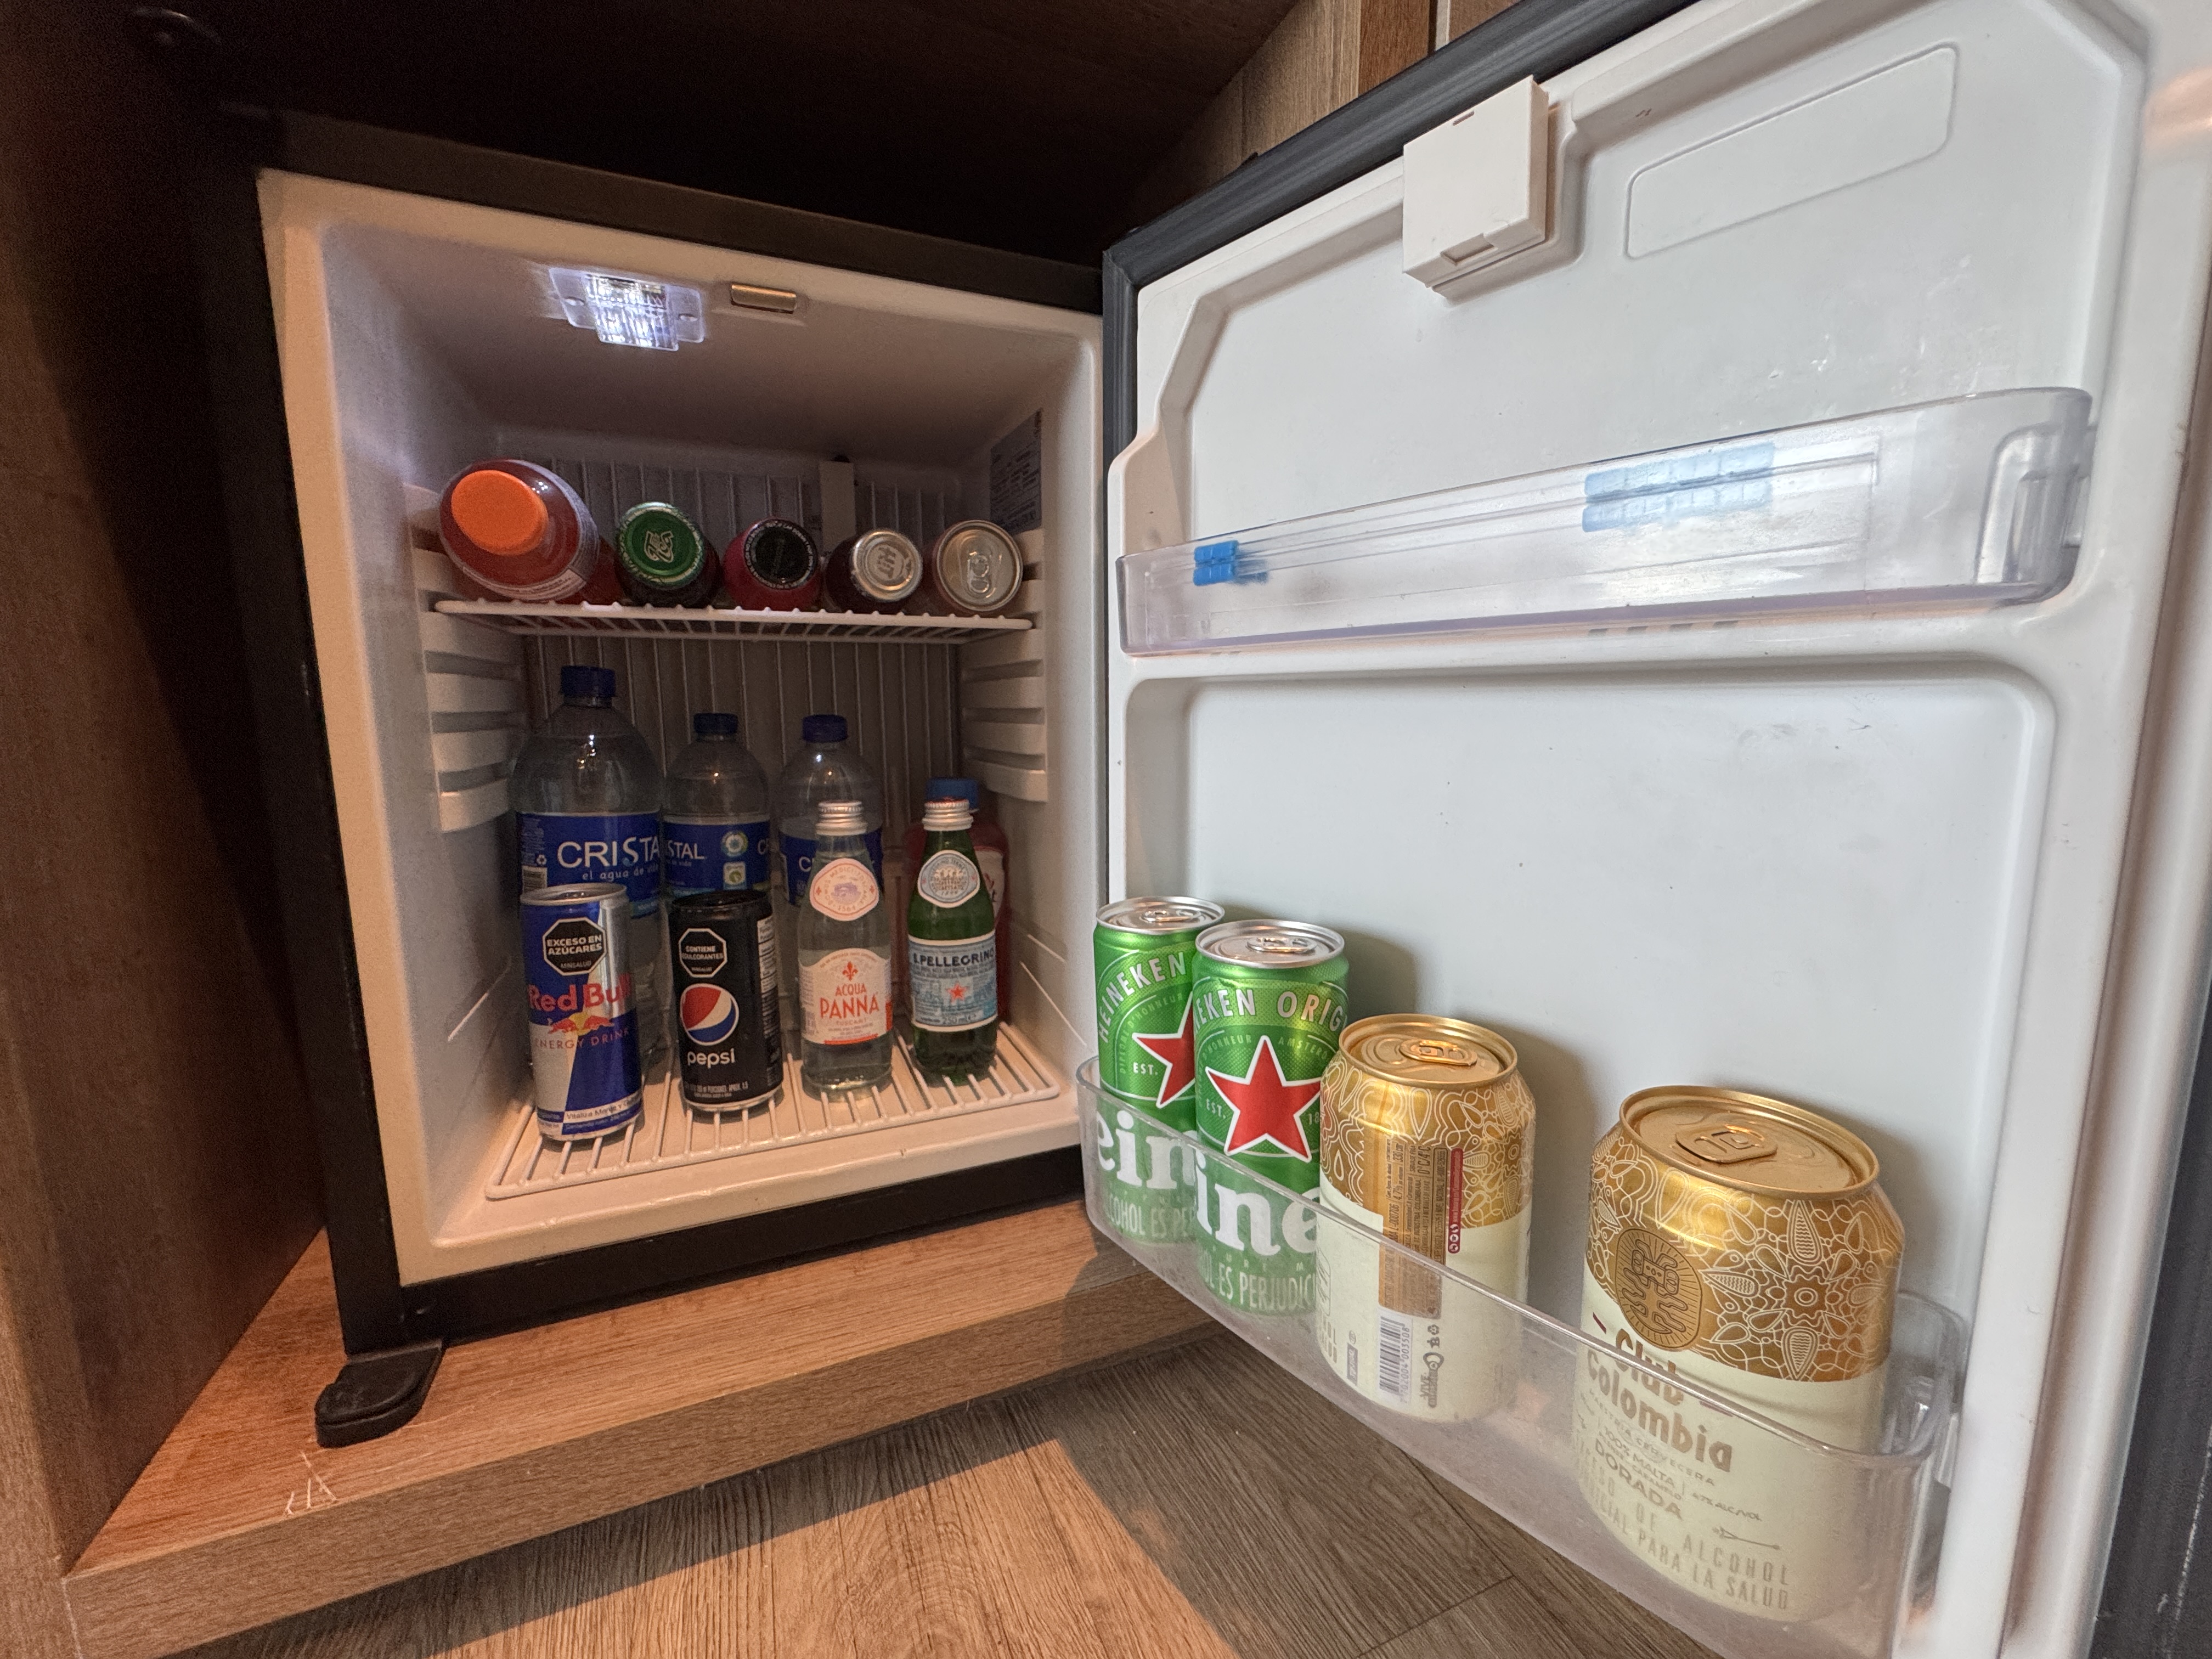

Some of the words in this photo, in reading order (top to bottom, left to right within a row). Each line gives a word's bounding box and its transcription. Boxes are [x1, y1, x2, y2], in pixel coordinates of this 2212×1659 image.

[557, 836, 659, 868] CRISTA
[668, 839, 706, 860] STAL
[582, 870, 592, 880] el
[600, 870, 629, 882] agua
[634, 867, 644, 876] de
[546, 935, 587, 947] EXCESO
[589, 934, 602, 944] EN
[548, 942, 602, 956] AZÚCARES
[528, 984, 578, 1012] Red
[836, 983, 867, 996] ACQUA
[1098, 952, 1186, 1043] HEINEKEN
[820, 994, 879, 1019] PANNA
[1194, 989, 1256, 1033] NEKEN
[1277, 991, 1343, 1031] ORIG
[534, 1036, 584, 1050] ENERGY
[591, 1028, 629, 1046] DRINK
[1278, 1036, 1328, 1060] AMSTERD
[687, 1047, 735, 1069] pepsi
[1133, 1062, 1158, 1075] EST.
[1206, 1098, 1227, 1119] EST.
[1219, 1262, 1233, 1300] ES
[1239, 1271, 1317, 1312] PERJUDICI
[1401, 1327, 1409, 1360] 003508
[1587, 1349, 1733, 1472] Colombia
[1595, 1438, 1684, 1522] DORADA
[1633, 1453, 1675, 1487] MALTA
[1683, 1534, 1788, 1586] ALCOHOL
[1727, 1576, 1789, 1610] SALUD
